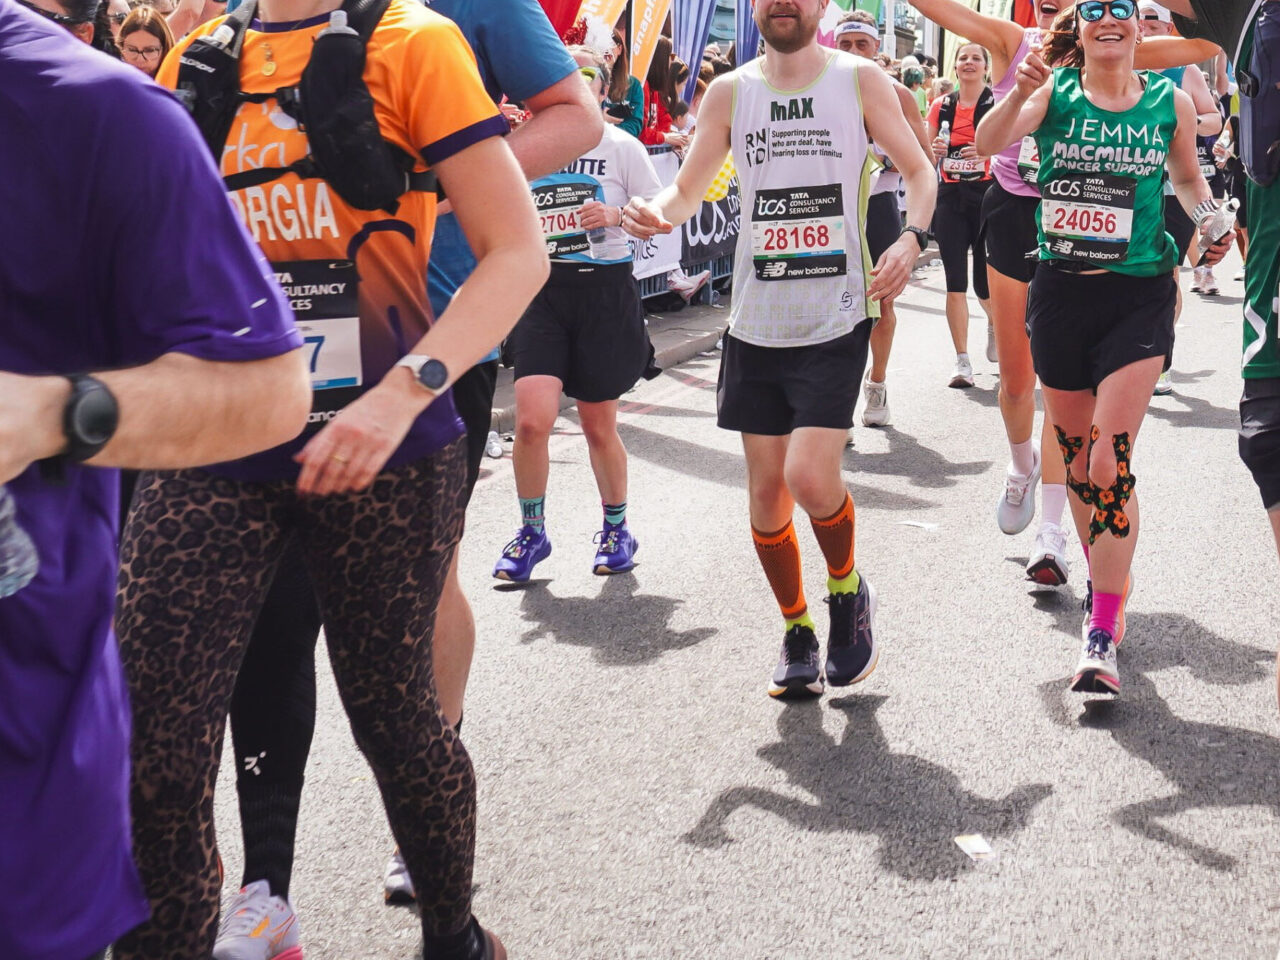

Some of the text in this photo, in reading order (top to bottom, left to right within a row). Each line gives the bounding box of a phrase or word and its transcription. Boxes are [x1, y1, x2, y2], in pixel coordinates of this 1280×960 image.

[771, 129, 830, 138] Supporting people
[1065, 118, 1164, 147] JEMMA
[772, 140, 785, 148] who
[772, 149, 795, 158] hearing
[819, 149, 843, 158] tinnitus
[1052, 141, 1166, 165] MACMILLAN
[1053, 158, 1157, 176] CANCER SUPPORT
[1086, 178, 1105, 186] TATA
[556, 190, 593, 199] CONSULTANCY
[1083, 185, 1130, 197] CONSULTANCY
[790, 192, 809, 200] TATA
[1082, 192, 1112, 201] SERVICES
[758, 195, 787, 216] tcs
[789, 197, 837, 207] CONSULTANCY
[788, 206, 820, 215] SERVICES
[1053, 208, 1117, 234] 24056
[764, 224, 830, 251] 28168
[1089, 251, 1120, 259] balance
[787, 266, 839, 277] new balance
